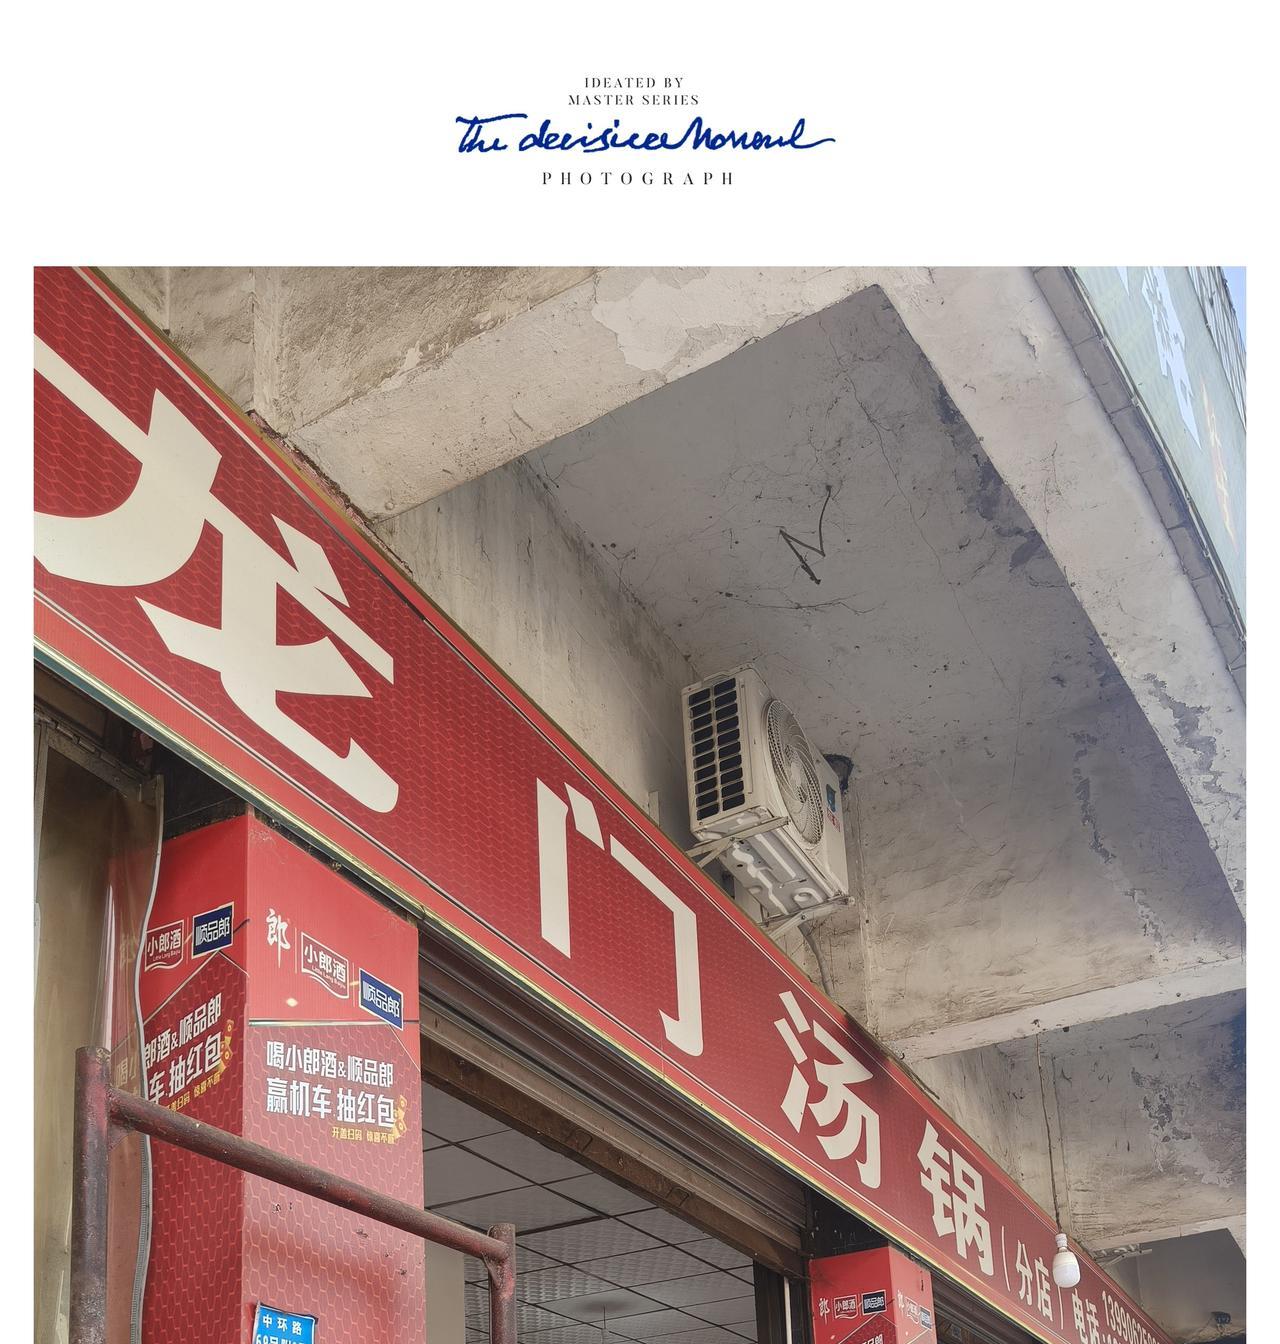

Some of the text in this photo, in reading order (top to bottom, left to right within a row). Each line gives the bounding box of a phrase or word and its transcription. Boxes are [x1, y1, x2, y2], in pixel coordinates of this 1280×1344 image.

[147, 928, 182, 957] 小郎酒
[195, 918, 230, 947] 顺品郎
[304, 944, 346, 983] 小郎酒
[363, 980, 400, 1018] 顺品郎
[266, 1041, 393, 1088] 喝小郎酒&顺品郎
[262, 1313, 303, 1336] 中环路
